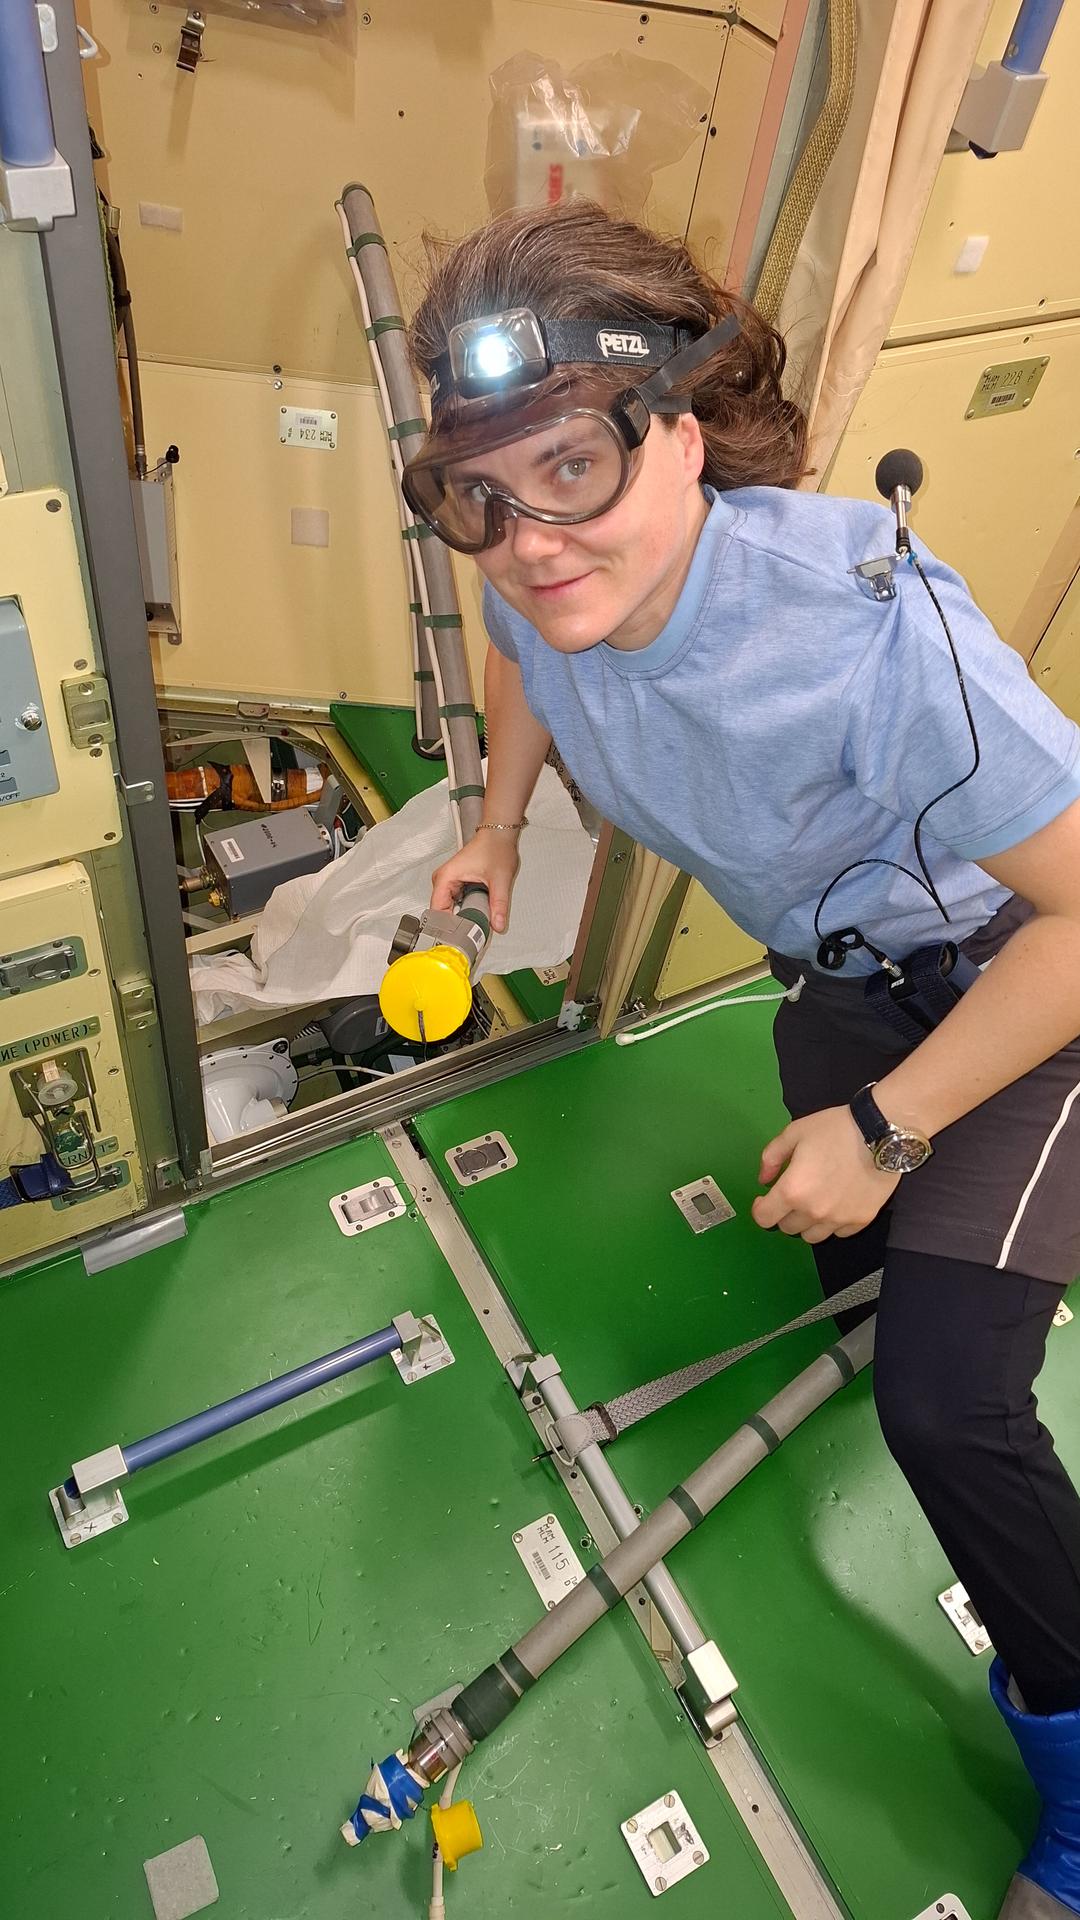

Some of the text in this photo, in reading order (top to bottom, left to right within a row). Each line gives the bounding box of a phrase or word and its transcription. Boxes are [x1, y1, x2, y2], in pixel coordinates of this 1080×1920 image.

[599, 332, 650, 358] PETZL
[1003, 370, 1023, 385] 228
[300, 428, 316, 440] 234
[24, 1024, 88, 1053] (POWER)
[536, 1526, 549, 1544] MLM
[548, 1545, 570, 1570] 115
